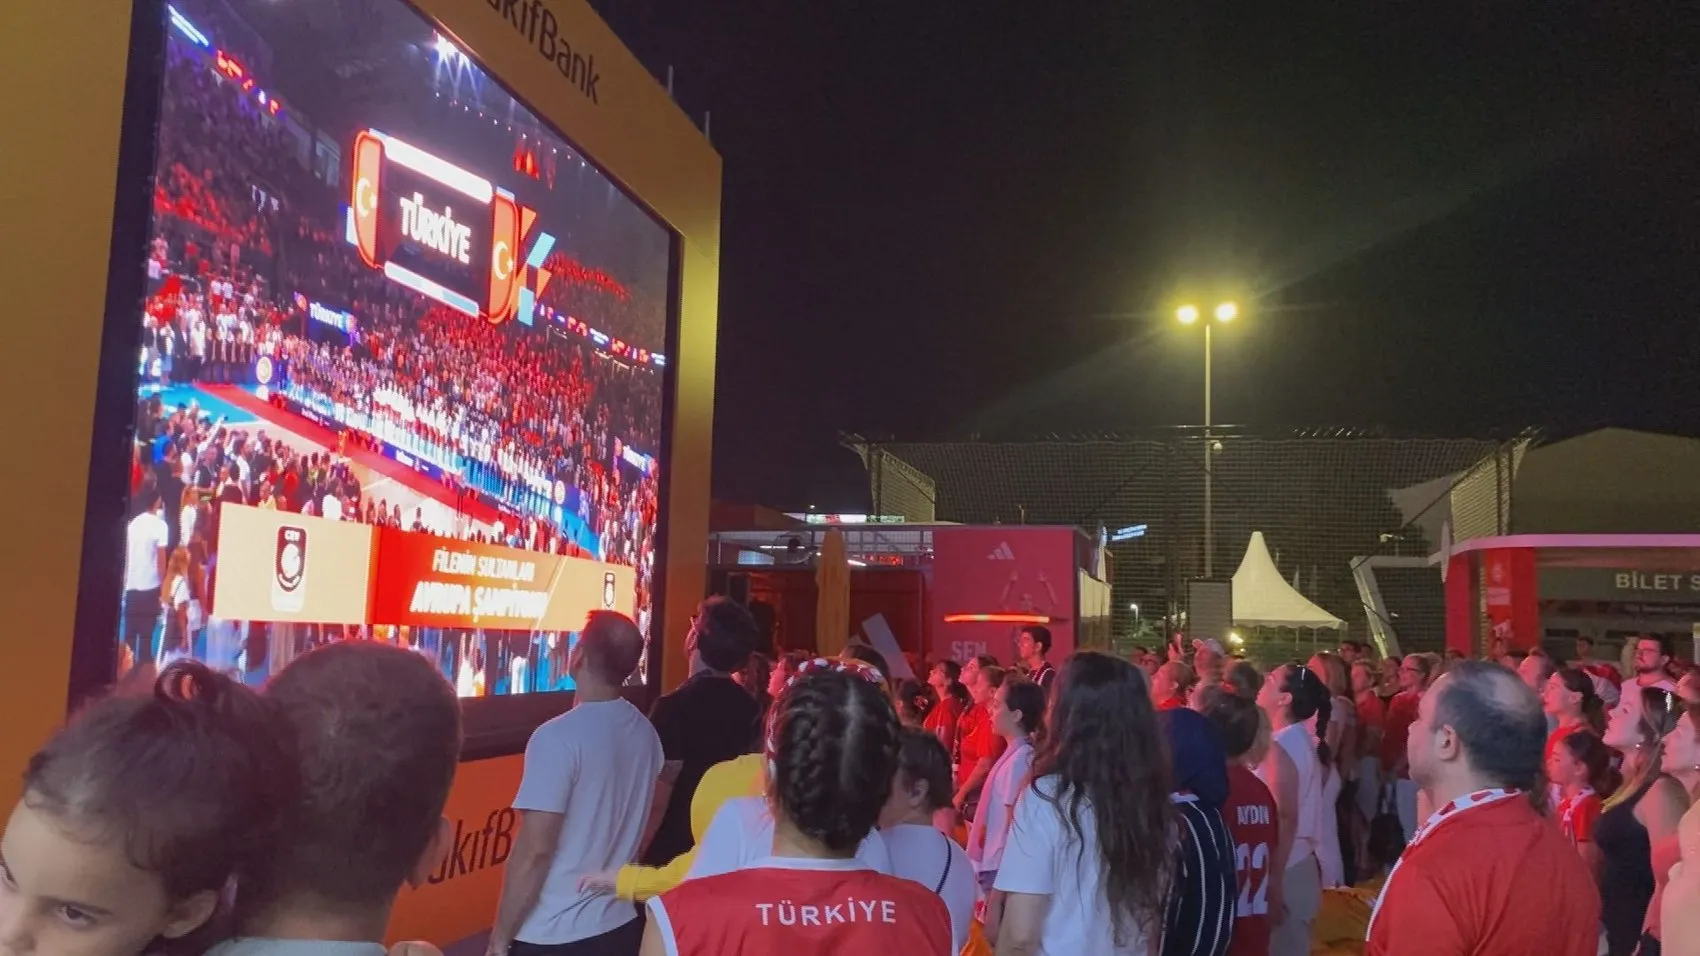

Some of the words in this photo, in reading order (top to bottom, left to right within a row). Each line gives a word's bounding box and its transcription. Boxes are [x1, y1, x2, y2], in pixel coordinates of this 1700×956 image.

[400, 191, 471, 265] TÜRKİYE
[1615, 570, 1683, 591] BİLET
[1690, 574, 1700, 592] S
[1236, 842, 1269, 917] 22
[755, 896, 897, 926] TÜRKİYE
